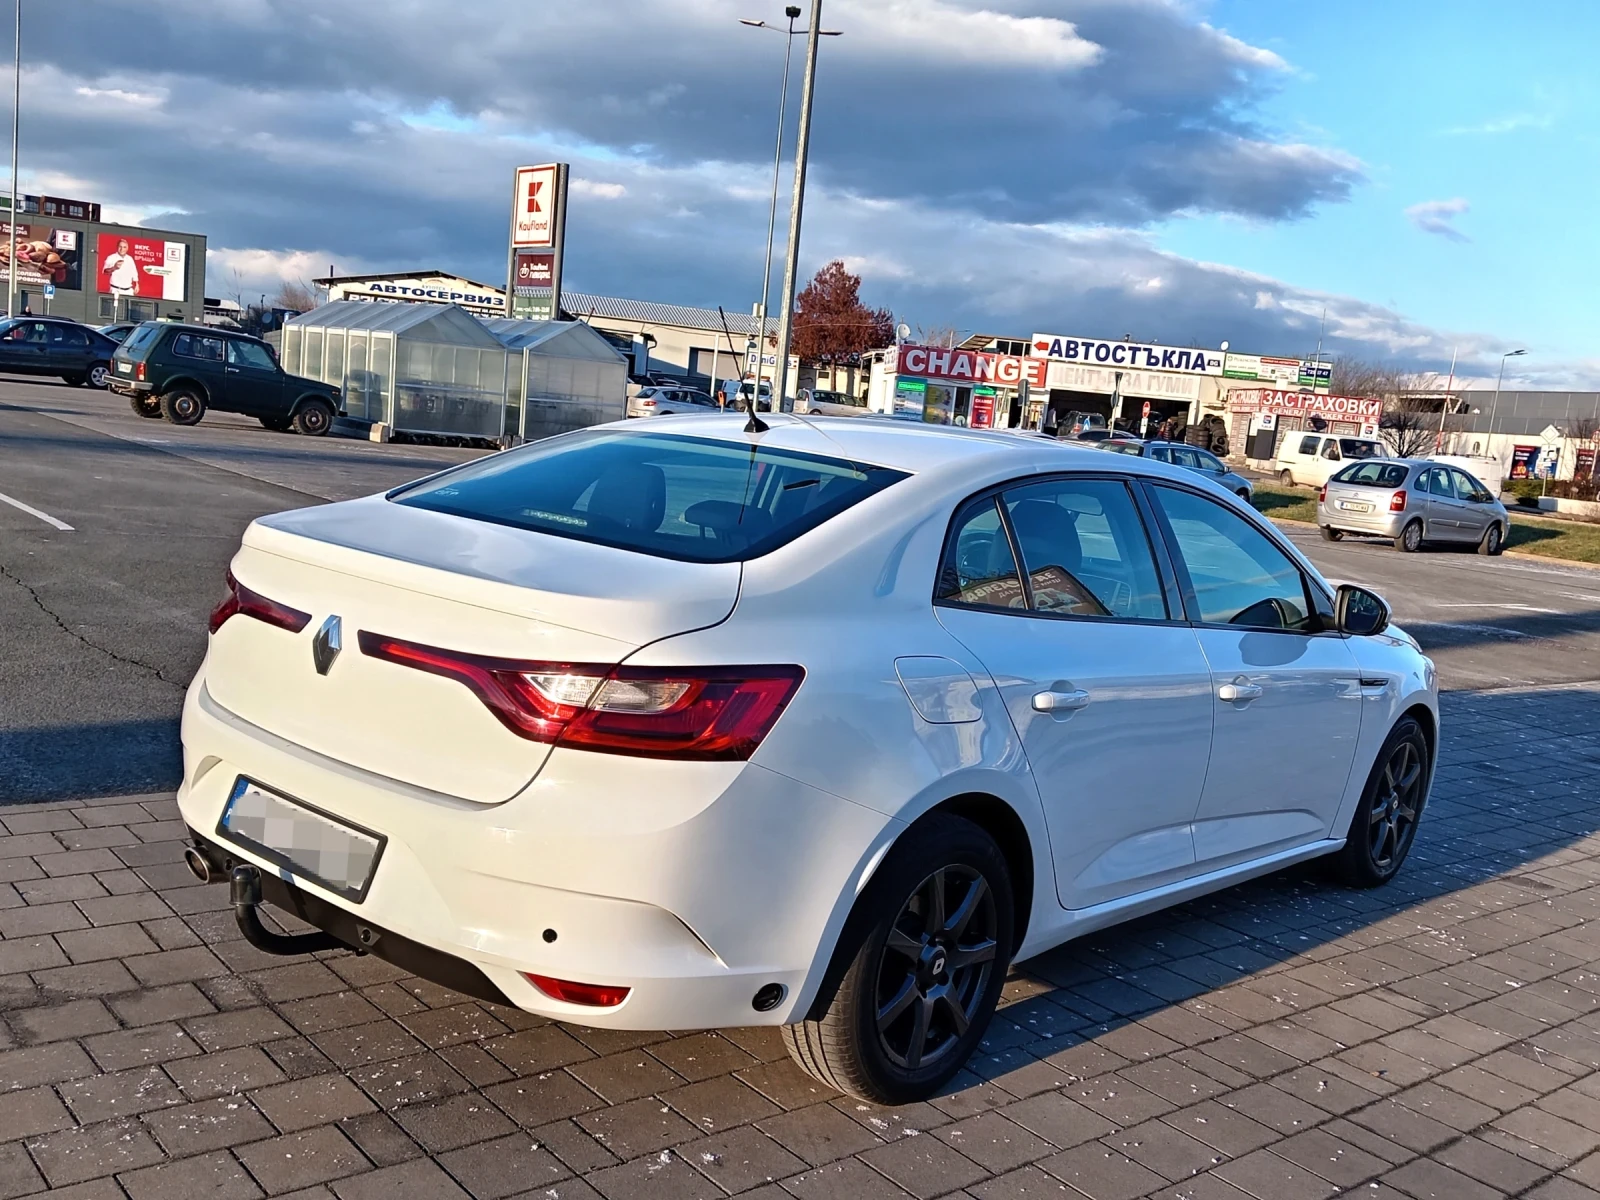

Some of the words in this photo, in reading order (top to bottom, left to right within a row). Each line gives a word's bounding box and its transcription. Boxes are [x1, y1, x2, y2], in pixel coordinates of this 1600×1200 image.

[518, 220, 548, 231] Kaufland
[46, 286, 53, 295] P
[369, 283, 505, 306] АВТОСЕРВИЗ
[1048, 338, 1207, 371] АВТОСТЪКЛА
[1209, 359, 1219, 367] BG
[905, 349, 1041, 384] CHANGE
[1052, 366, 1116, 387] ЦЕНТЪР
[1121, 372, 1142, 390] ЗА
[1147, 374, 1194, 395] ГУМИ
[1262, 390, 1380, 415] ЗАСТРАХОВКИ
[1344, 414, 1366, 423] CLUB
